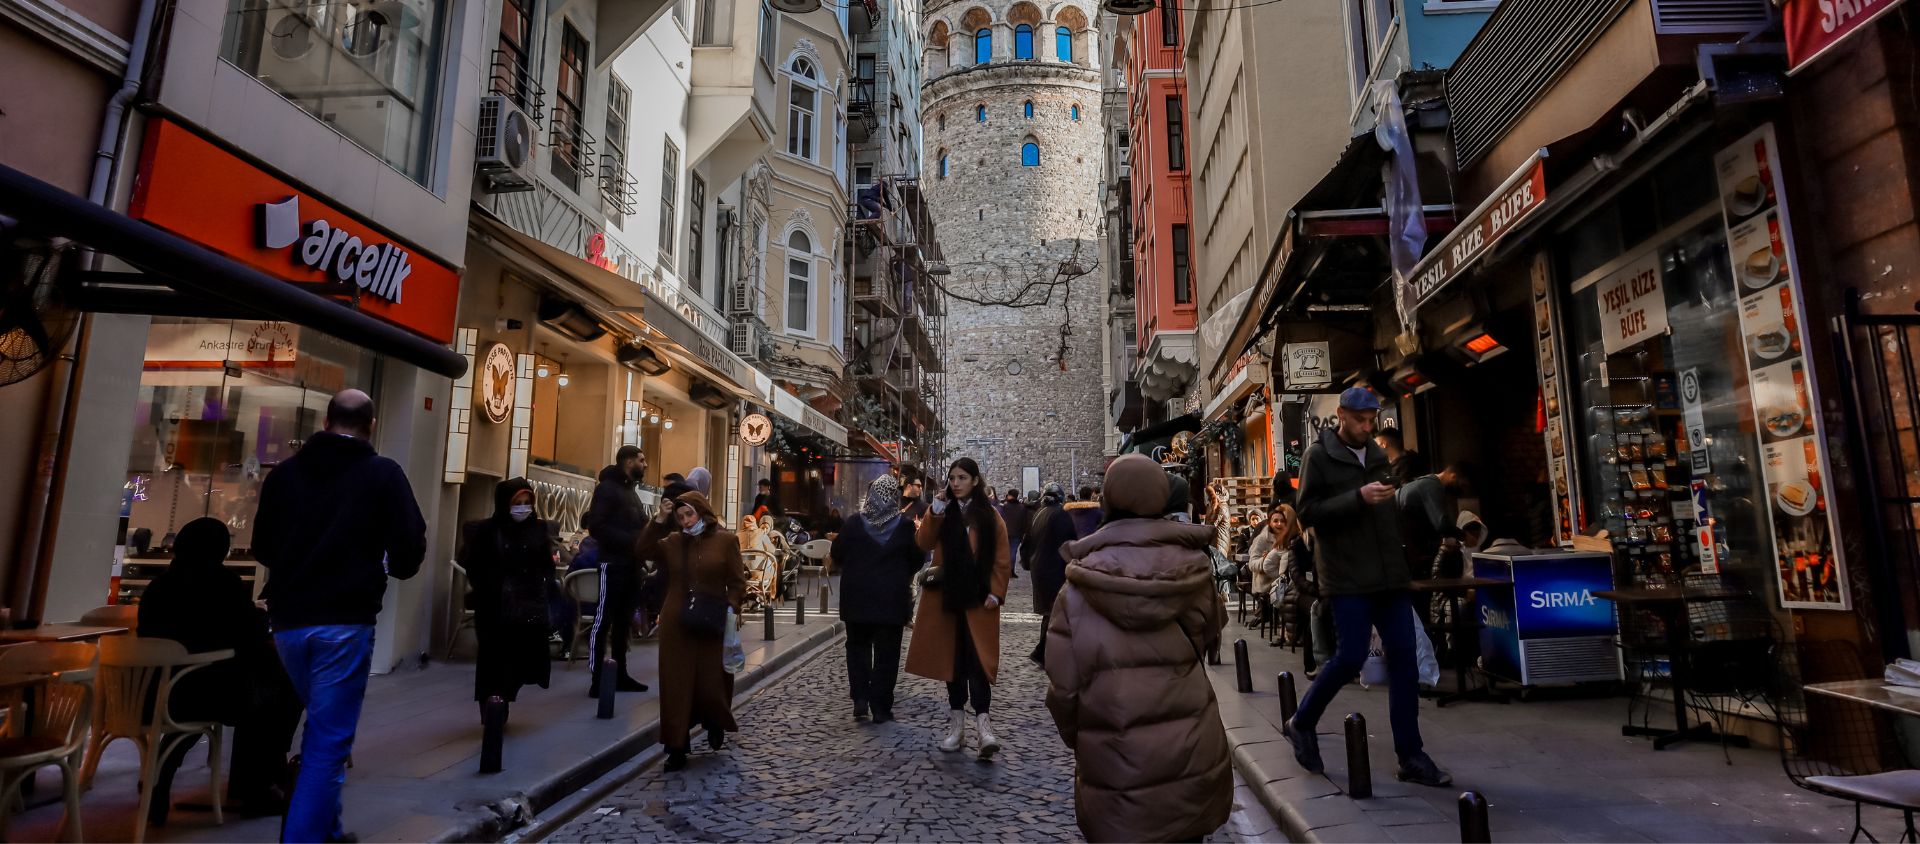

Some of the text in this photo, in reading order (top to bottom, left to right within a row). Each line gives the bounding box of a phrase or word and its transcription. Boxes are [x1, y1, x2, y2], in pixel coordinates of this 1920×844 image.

[1452, 224, 1484, 269] RİZE
[1490, 178, 1534, 235] BÜFE
[1603, 268, 1657, 314] YEŞİL RİZE
[1619, 307, 1647, 339] BÜFE
[200, 339, 244, 350] Ankastre
[486, 348, 497, 371] ROSE
[1530, 589, 1598, 608] SIRMA
[1481, 604, 1510, 630] SIRMA
